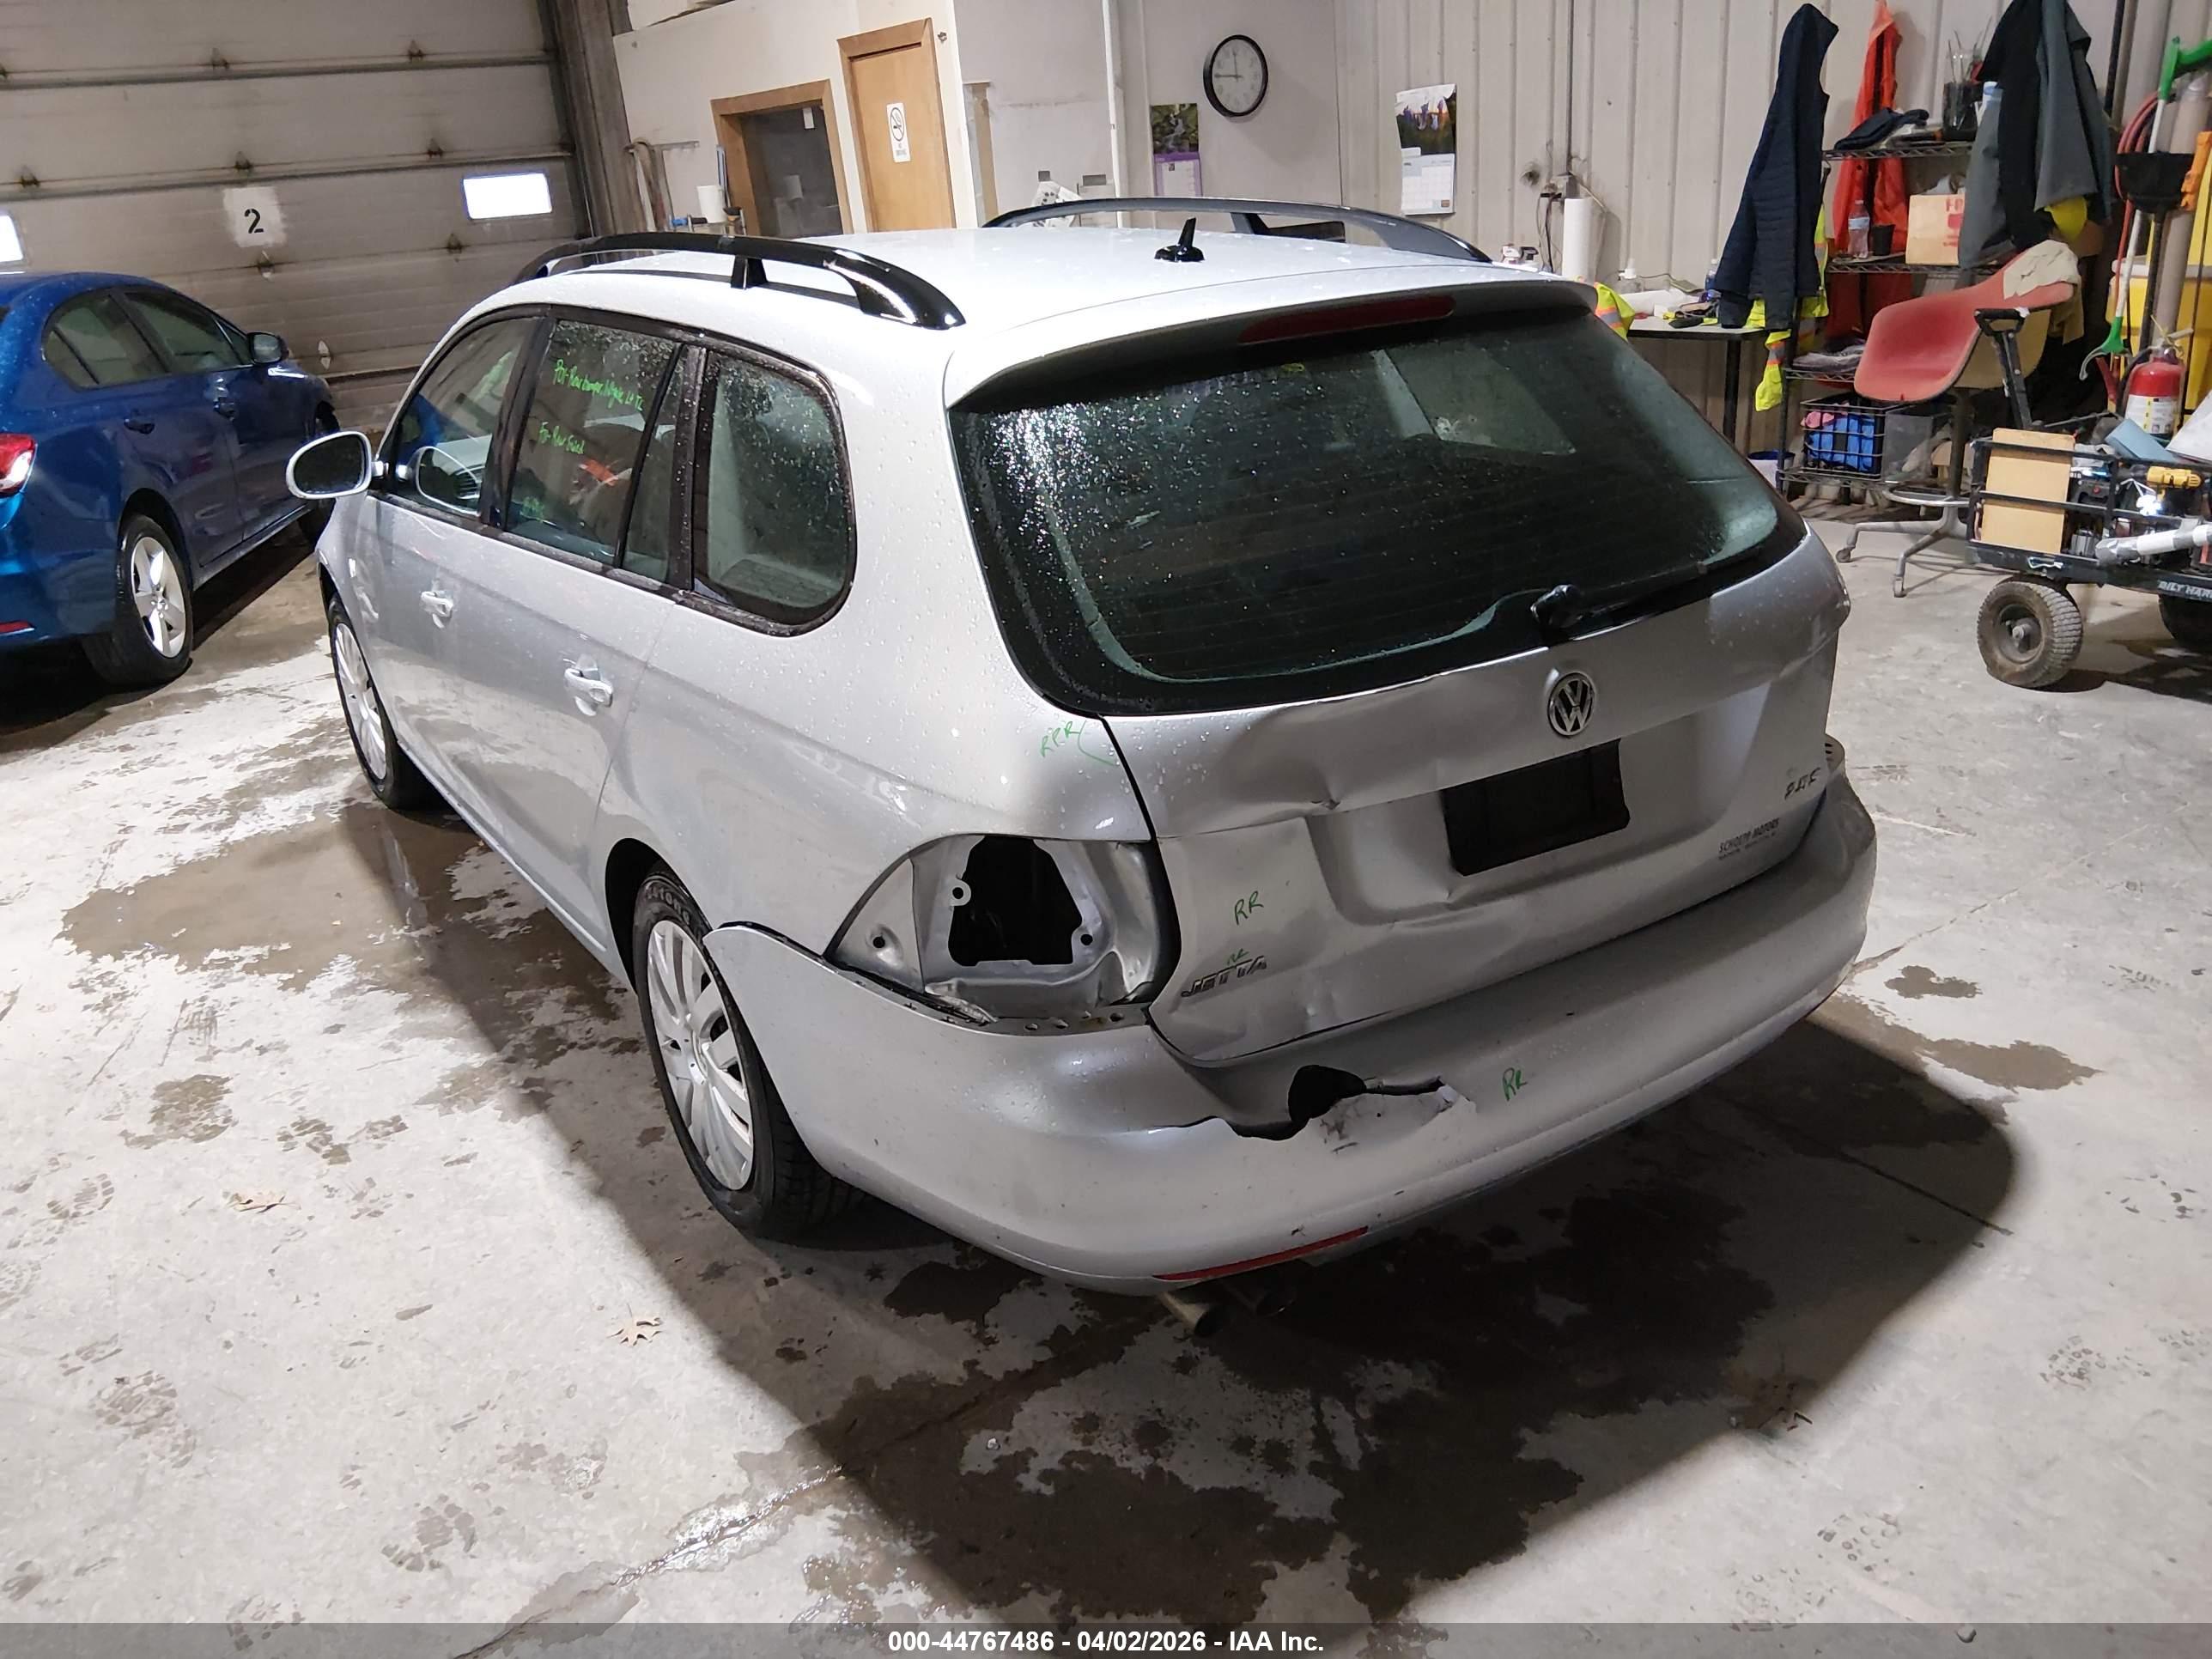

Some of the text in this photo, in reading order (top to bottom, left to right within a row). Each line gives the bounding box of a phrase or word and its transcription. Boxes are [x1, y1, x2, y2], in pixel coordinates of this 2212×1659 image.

[244, 208, 264, 234] 2
[1548, 671, 1596, 737] VW
[1181, 955, 1267, 998] JETTA
